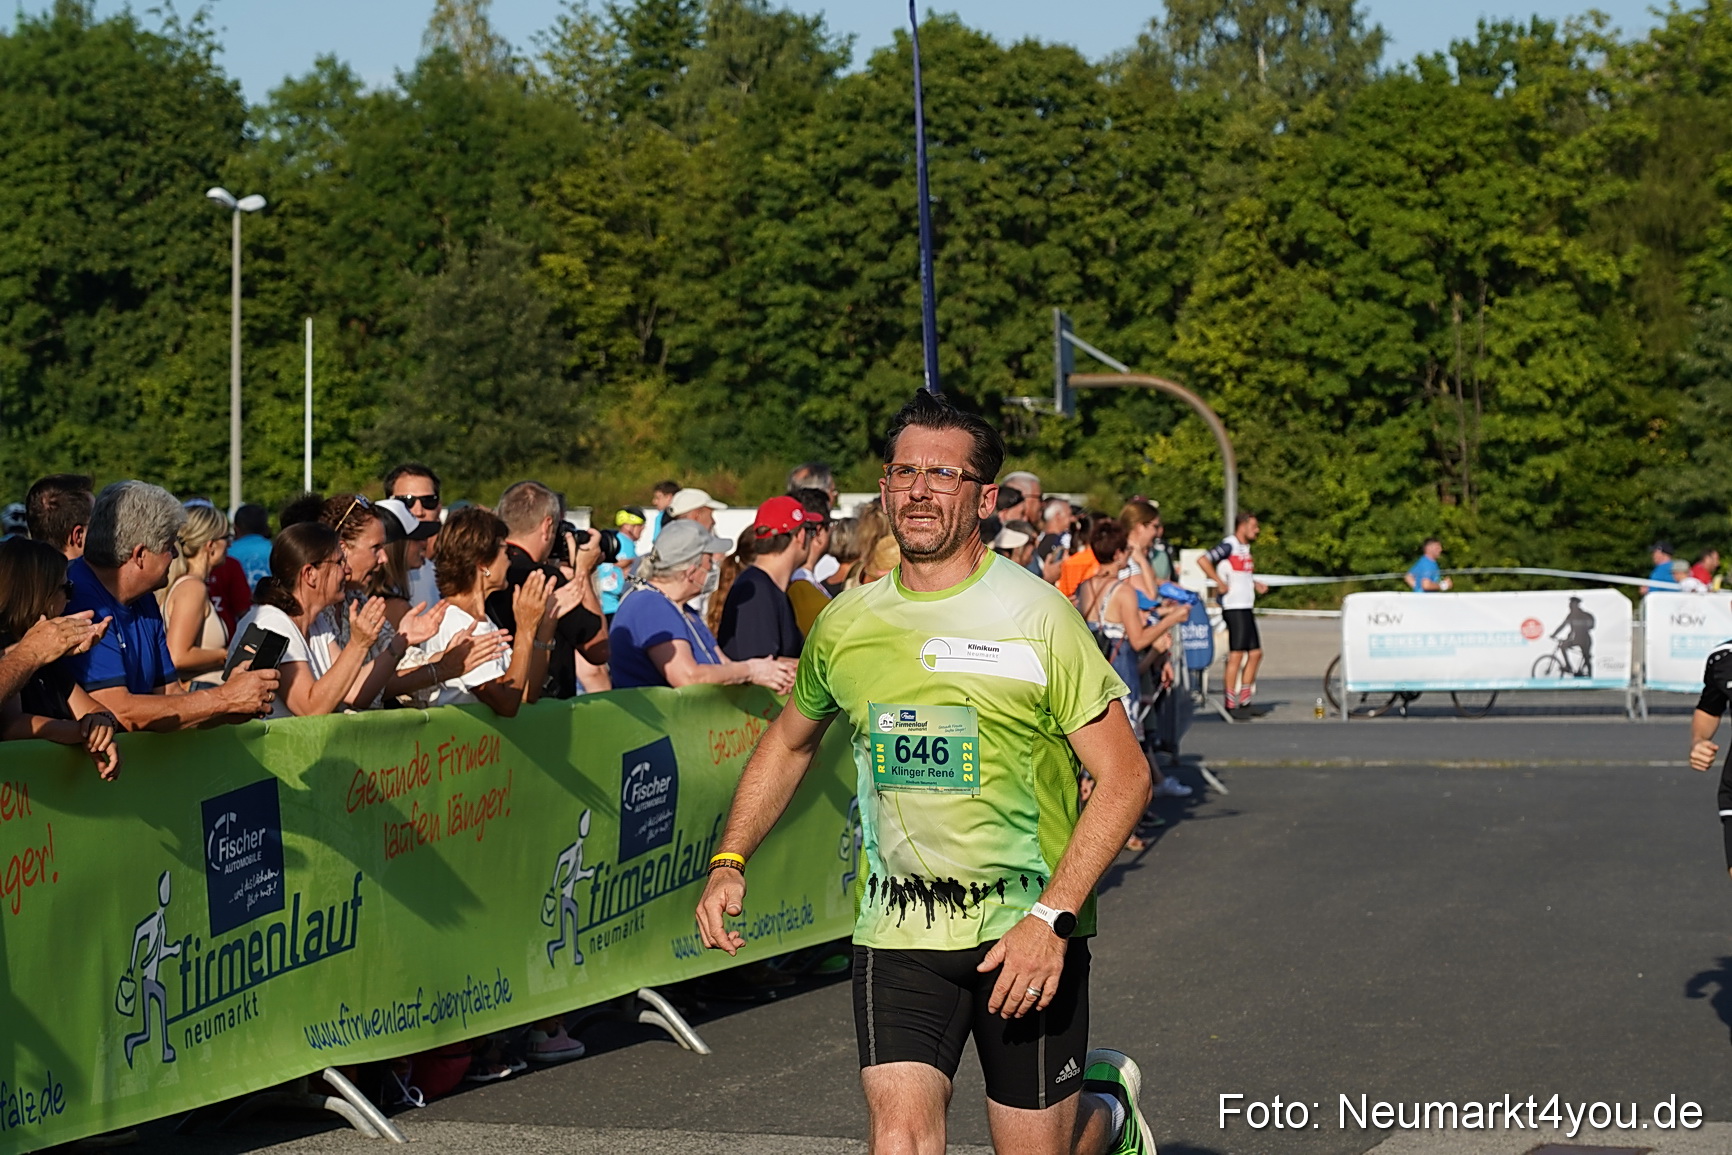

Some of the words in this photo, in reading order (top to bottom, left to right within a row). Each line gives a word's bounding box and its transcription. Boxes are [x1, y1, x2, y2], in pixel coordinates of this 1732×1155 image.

[966, 651, 999, 659] Neumarkt
[967, 643, 1000, 653] Klinikum
[895, 720, 928, 728] Firmenlauf
[876, 743, 886, 774] RUN
[894, 735, 950, 765] 646
[962, 742, 974, 782] 2022
[346, 740, 432, 814] Gesunde
[437, 735, 500, 782] Firmen
[631, 775, 672, 804] Fischer
[891, 765, 925, 779] Klinger
[927, 767, 955, 778] René
[384, 800, 441, 861] laufen
[447, 769, 513, 842] länger!
[218, 827, 266, 863] Fischer
[224, 850, 262, 876] AUTOMOBILE
[0, 822, 59, 916] ger!
[590, 813, 723, 926] firmenlauf
[179, 871, 363, 1015] firmenlauf
[589, 909, 645, 955] neumarkt
[184, 991, 259, 1050] neumarkt
[303, 967, 513, 1051] www.firmenlauf-oberpfalz.de
[1055, 1067, 1081, 1084] adidas
